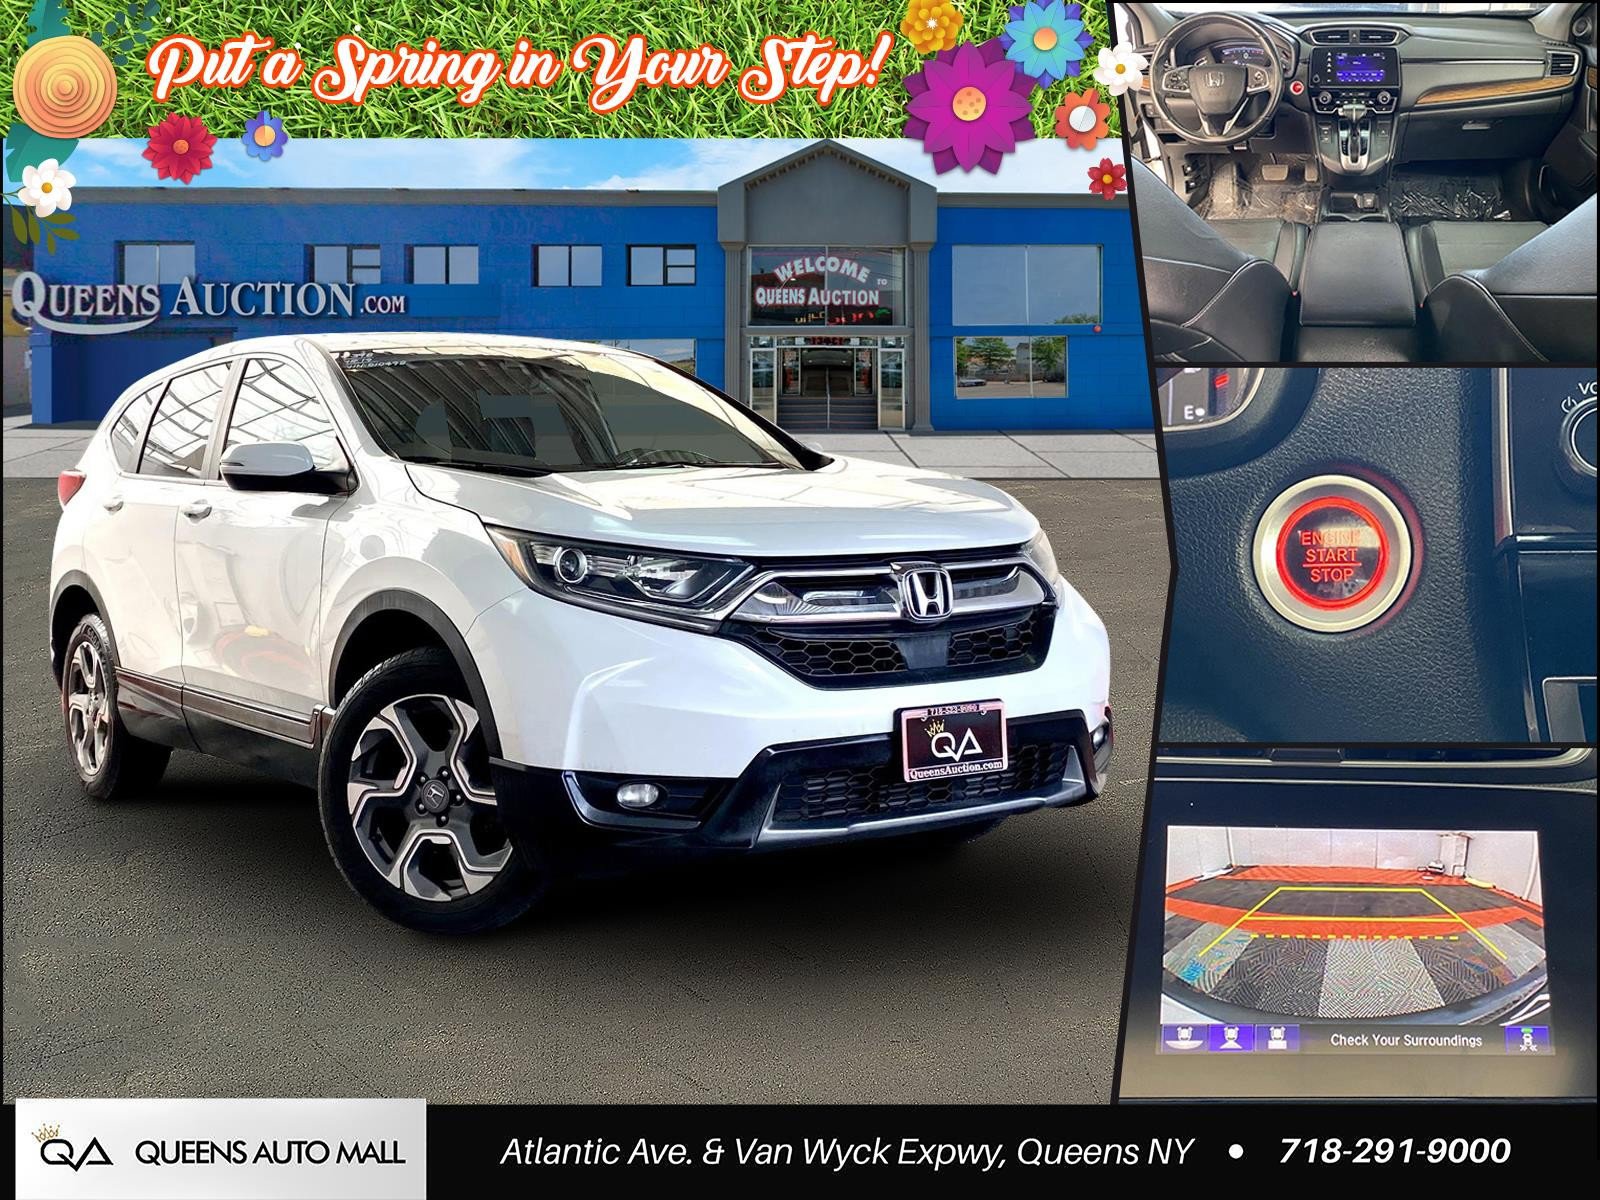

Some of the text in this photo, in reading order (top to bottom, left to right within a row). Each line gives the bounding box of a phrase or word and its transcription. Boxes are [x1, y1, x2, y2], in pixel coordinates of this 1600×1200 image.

[774, 256, 871, 283] WELCOME
[877, 278, 888, 286] TO
[12, 271, 161, 334] QUEENS
[755, 286, 880, 305] QUEENS AUCTION
[1184, 405, 1194, 420] E
[1301, 530, 1362, 547] ENGINE
[1305, 548, 1358, 562] START
[1310, 567, 1355, 583] STOP
[909, 762, 1003, 779] QueensAuction.com
[1330, 1032, 1483, 1049] Check Your Surroundings
